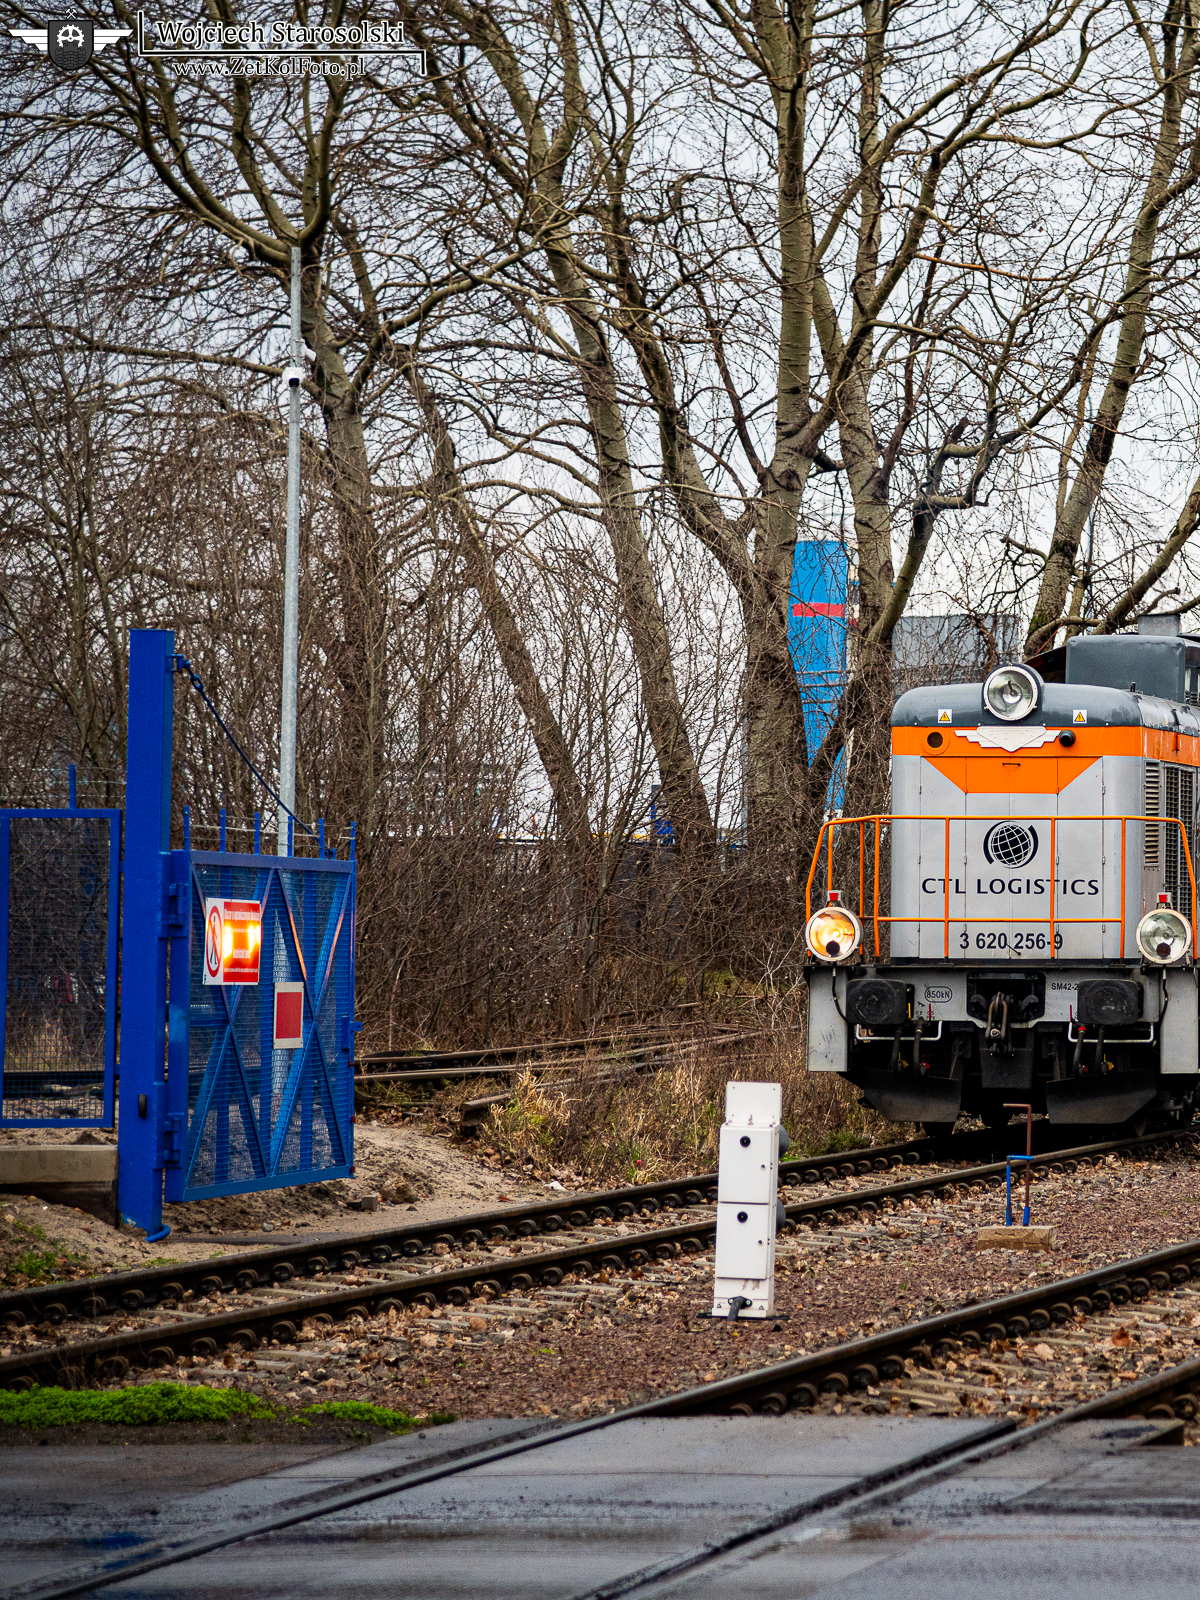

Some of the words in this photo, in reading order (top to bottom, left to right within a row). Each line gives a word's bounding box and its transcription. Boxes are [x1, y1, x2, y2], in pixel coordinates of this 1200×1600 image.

[921, 878, 967, 894] CTL
[976, 878, 1099, 896] LOGISTICS
[959, 932, 970, 950] 3
[975, 932, 1008, 950] 620
[1013, 933, 1064, 950] 256-9
[926, 990, 950, 999] 850kN
